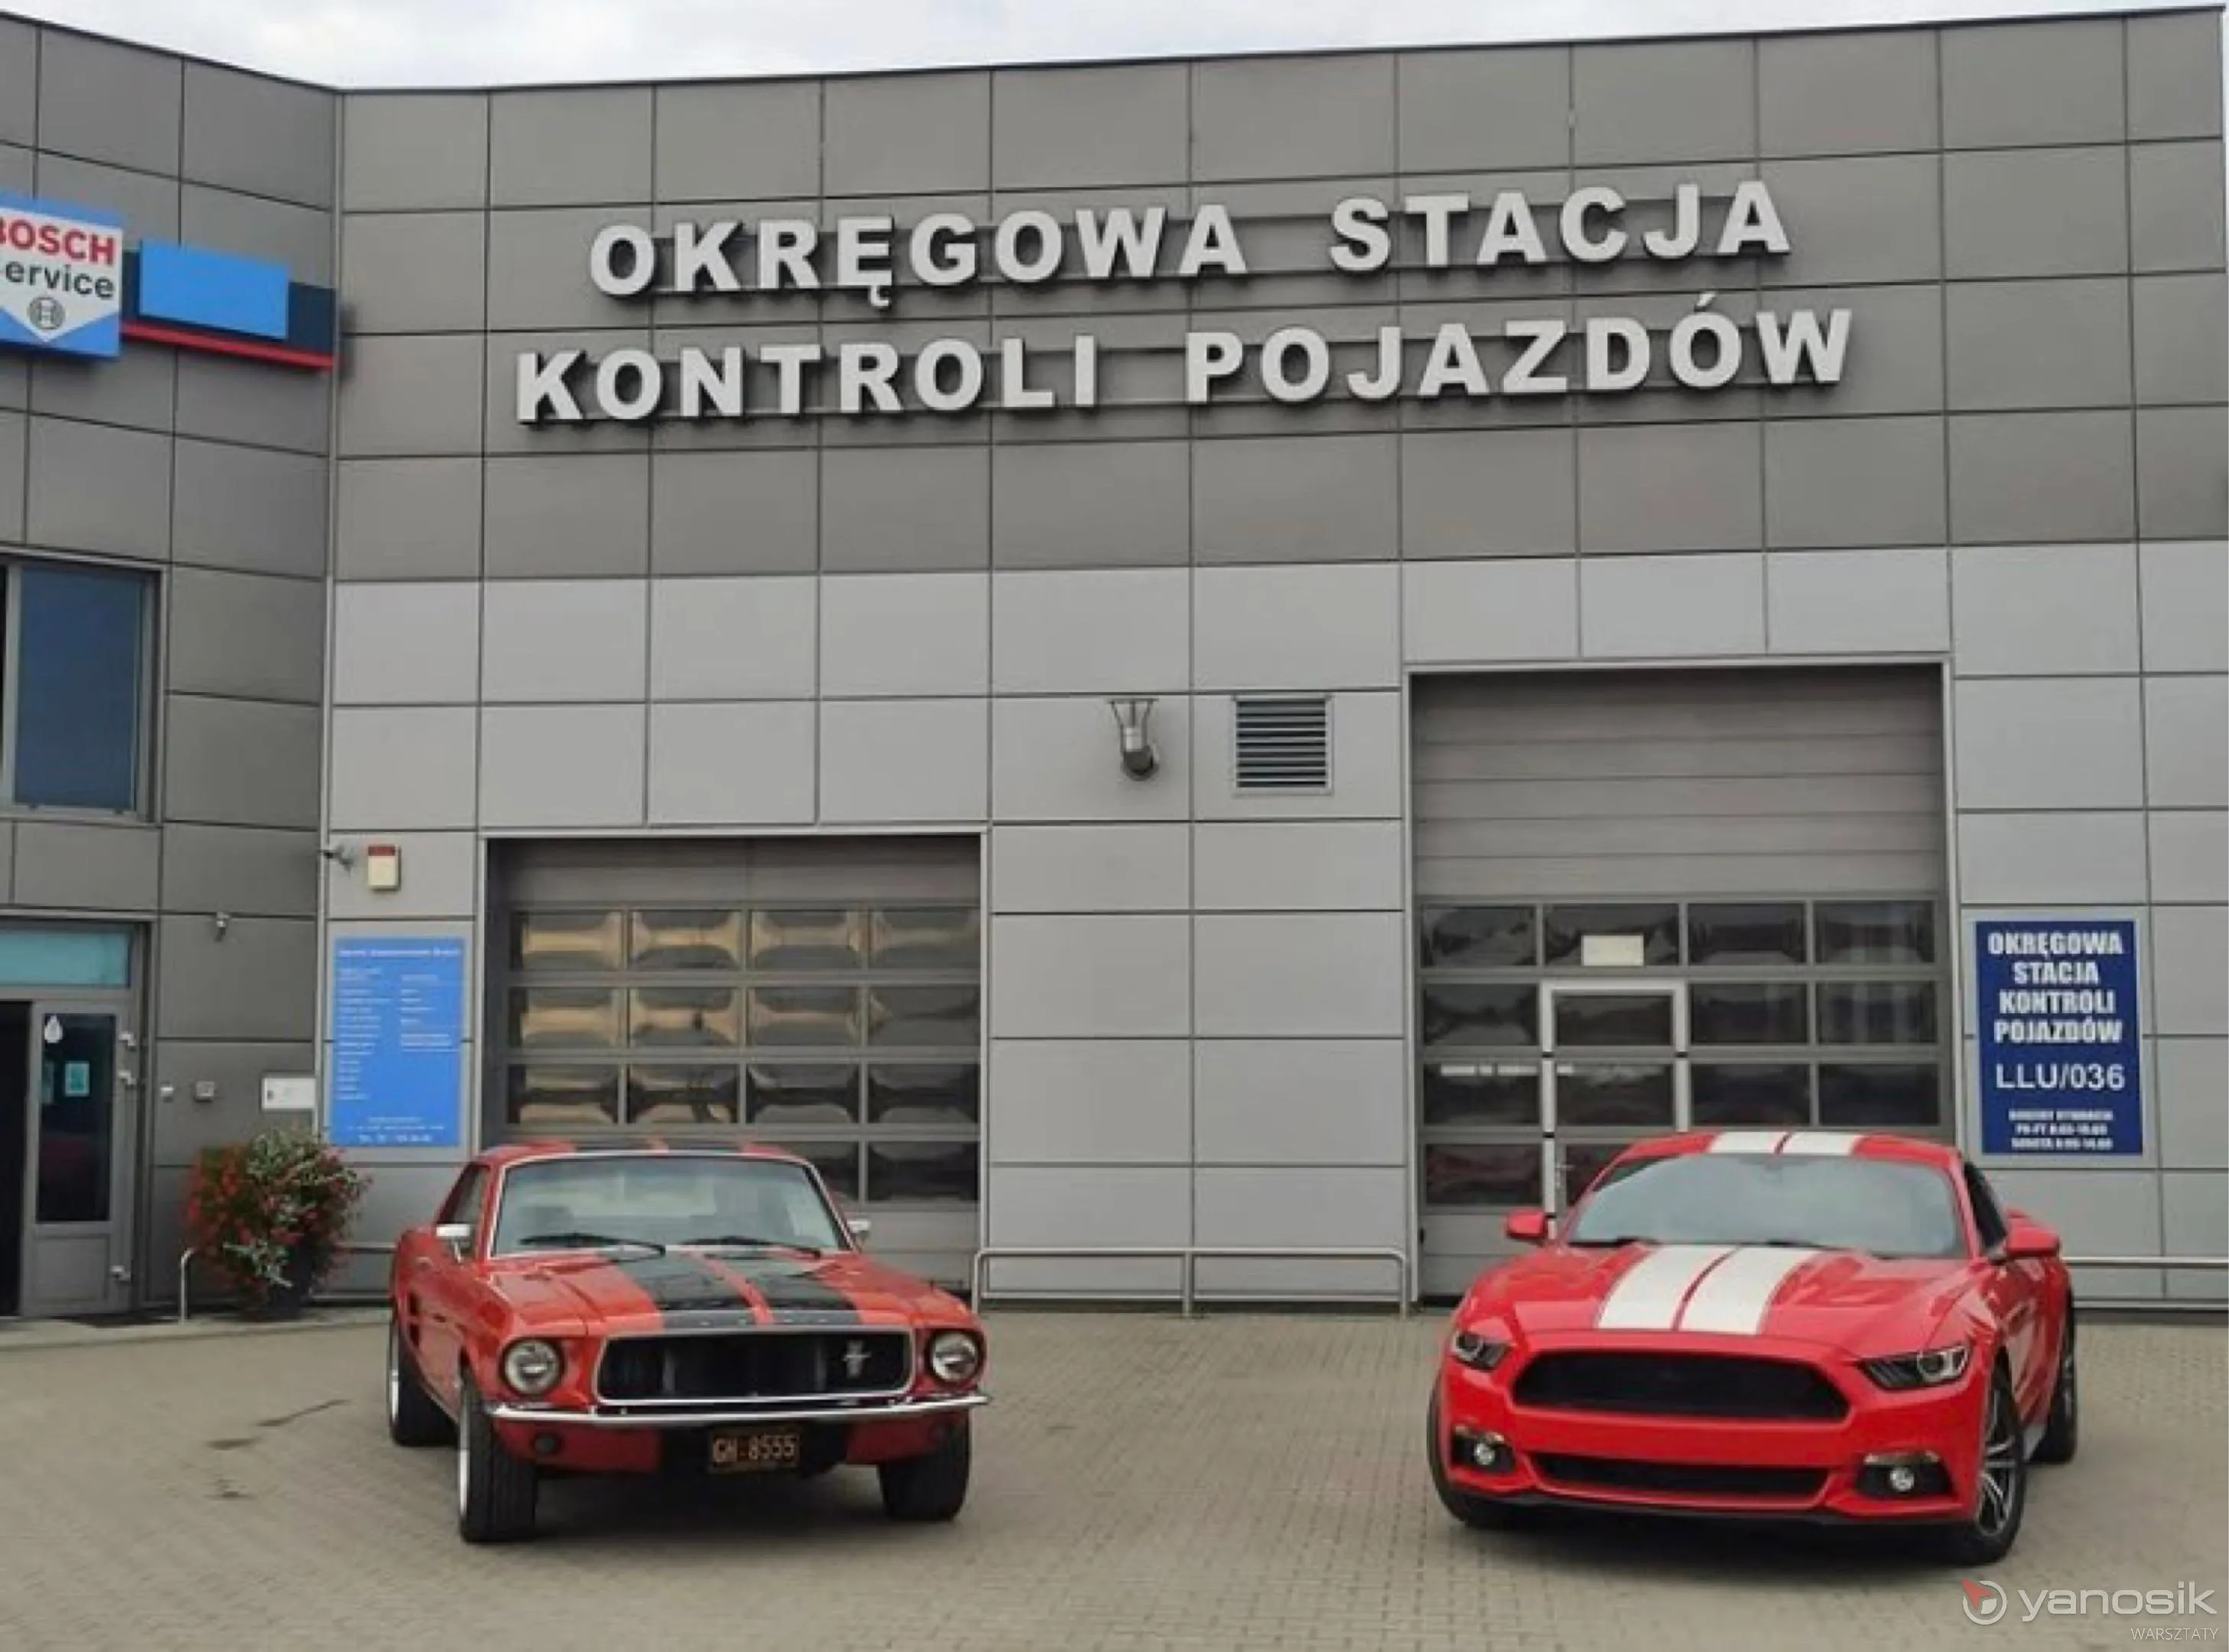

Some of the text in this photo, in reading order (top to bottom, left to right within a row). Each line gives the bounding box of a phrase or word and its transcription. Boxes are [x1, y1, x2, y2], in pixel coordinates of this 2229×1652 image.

[0, 216, 114, 265] OSCH
[590, 180, 1791, 307] OKRĘGOWA STACJA
[0, 261, 114, 301] ervice
[516, 292, 1853, 424] KONTROLI POJAZDÓW
[1988, 932, 2123, 958] OKRĘGOWA
[2013, 961, 2100, 985] STACJA
[1999, 990, 2117, 1014] KONTROLI
[1993, 1016, 2123, 1044] POJAZDÓW
[1995, 1063, 2126, 1091] LLU/036
